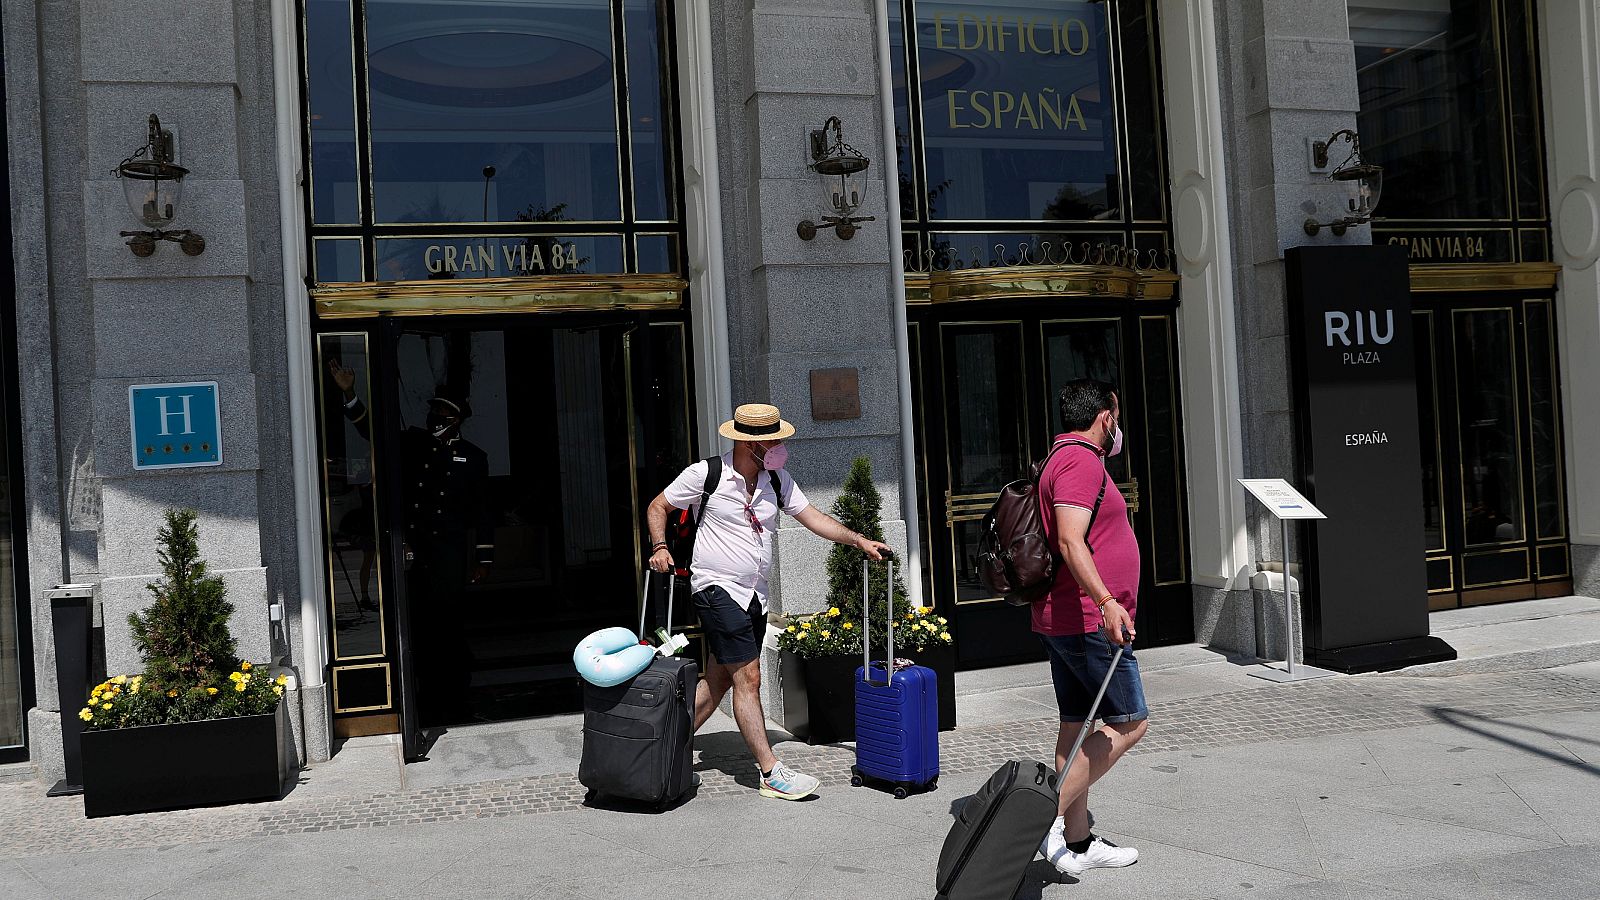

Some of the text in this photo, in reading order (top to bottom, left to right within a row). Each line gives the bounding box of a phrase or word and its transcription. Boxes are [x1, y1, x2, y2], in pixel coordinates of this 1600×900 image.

[934, 12, 1089, 56] EDIFICIO
[947, 87, 1087, 131] ESPAÑA
[424, 244, 579, 273] GRAN VIA 84
[1435, 237, 1463, 258] VIA
[1466, 236, 1484, 257] 84
[1324, 309, 1394, 347] RIU
[1343, 352, 1380, 365] PLAZA
[154, 394, 196, 436] H
[1345, 430, 1389, 446] ESPAÑA
